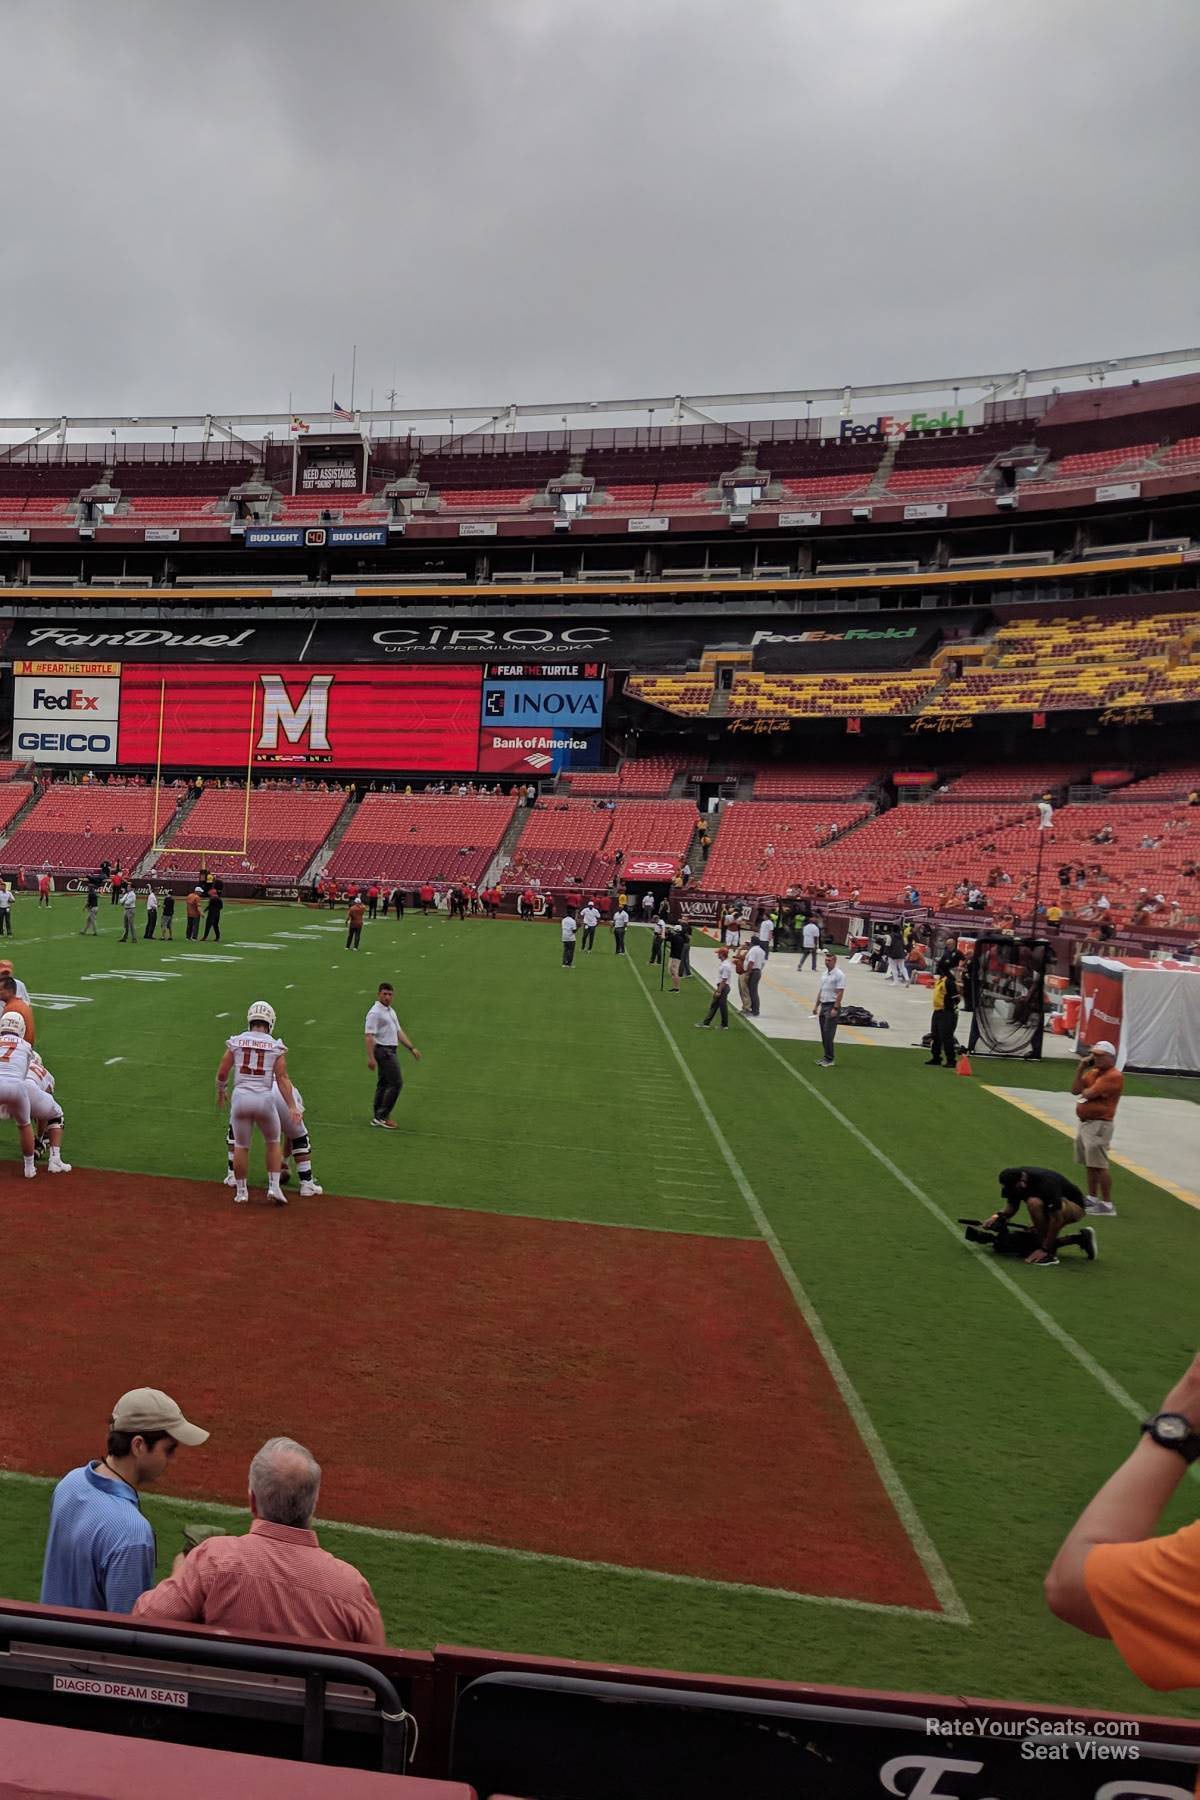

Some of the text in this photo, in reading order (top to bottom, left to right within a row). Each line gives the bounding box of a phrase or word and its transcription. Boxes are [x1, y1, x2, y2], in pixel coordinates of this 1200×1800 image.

[840, 409, 964, 438] FedExField
[303, 467, 357, 480] NEED ASSISTANCE
[250, 534, 299, 543] BUD LIGHT
[308, 532, 323, 543] 40
[332, 532, 383, 541] BUD LIGHT
[26, 627, 256, 648] FanDuel
[751, 627, 918, 646] FedExField
[384, 645, 440, 653] ULTRA
[531, 644, 594, 652] VODKA
[36, 663, 113, 674] #FEARTHETURTLE
[491, 665, 579, 677] #FEARTHETURTLE
[33, 689, 99, 711] FedEx
[513, 693, 598, 715] INOVA
[18, 733, 111, 753] GEICO
[493, 737, 587, 750] Bank of America
[239, 1047, 266, 1076] 11
[55, 1677, 186, 1705] DIAGEO DREAM SEATS
